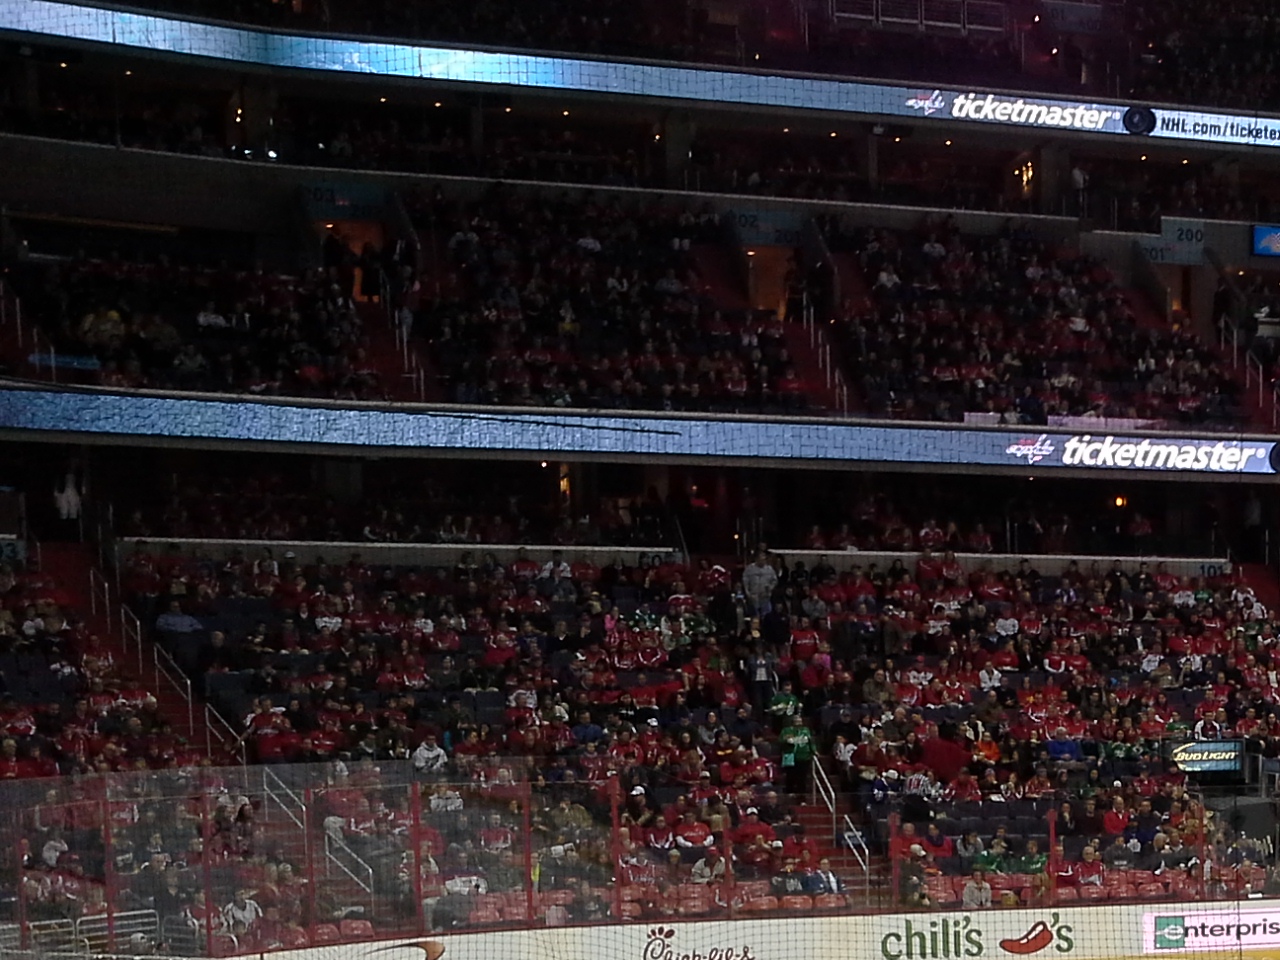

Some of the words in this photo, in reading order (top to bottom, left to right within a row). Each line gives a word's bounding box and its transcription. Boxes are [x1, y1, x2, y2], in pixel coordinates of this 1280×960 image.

[951, 93, 1111, 129] ticketmaster
[1177, 228, 1203, 242] 200
[1062, 435, 1255, 471] ticketmaster
[881, 915, 984, 960] chili's
